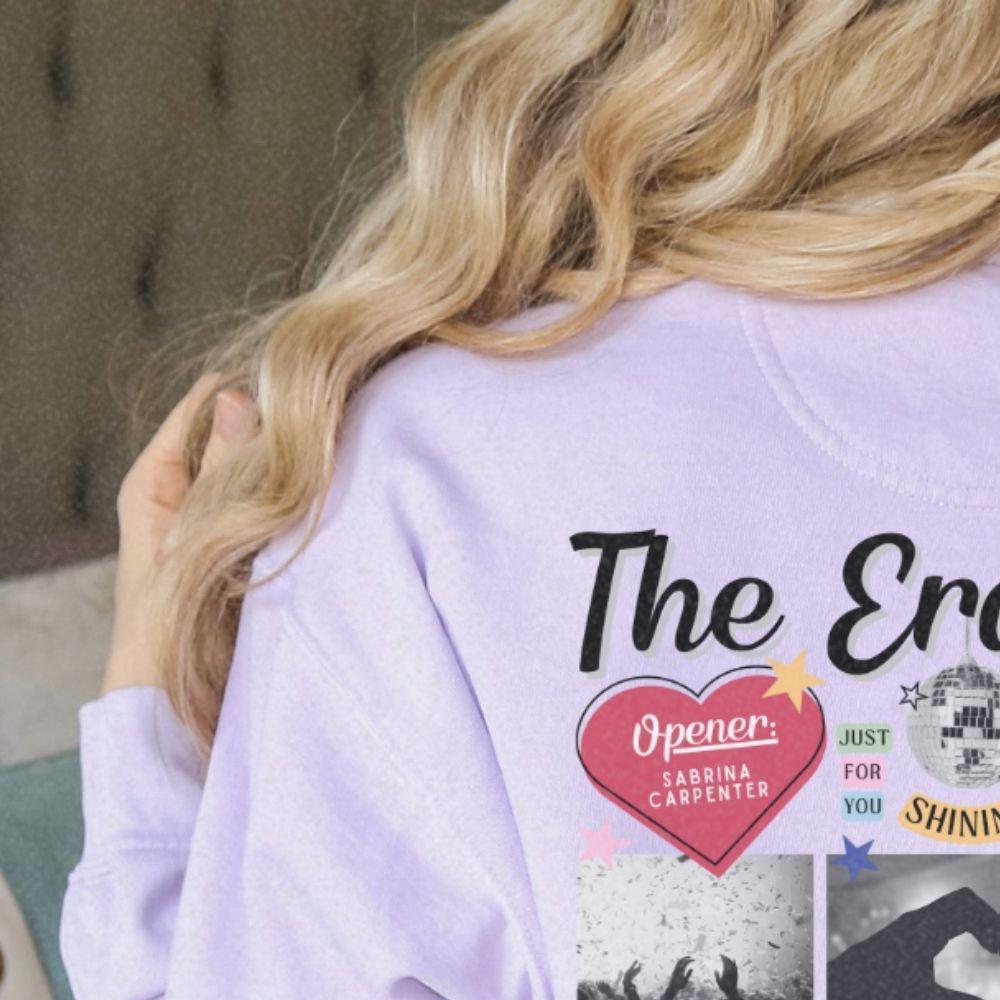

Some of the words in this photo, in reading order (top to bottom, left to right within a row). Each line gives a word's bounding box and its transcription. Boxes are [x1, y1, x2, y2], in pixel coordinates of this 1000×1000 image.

[569, 528, 785, 672] The
[632, 713, 779, 762] Opener:
[839, 729, 890, 746] JUST
[662, 763, 751, 788] SABRINA
[844, 763, 881, 779] FOR
[649, 781, 769, 808] CARPENTER
[844, 798, 882, 814] YOU
